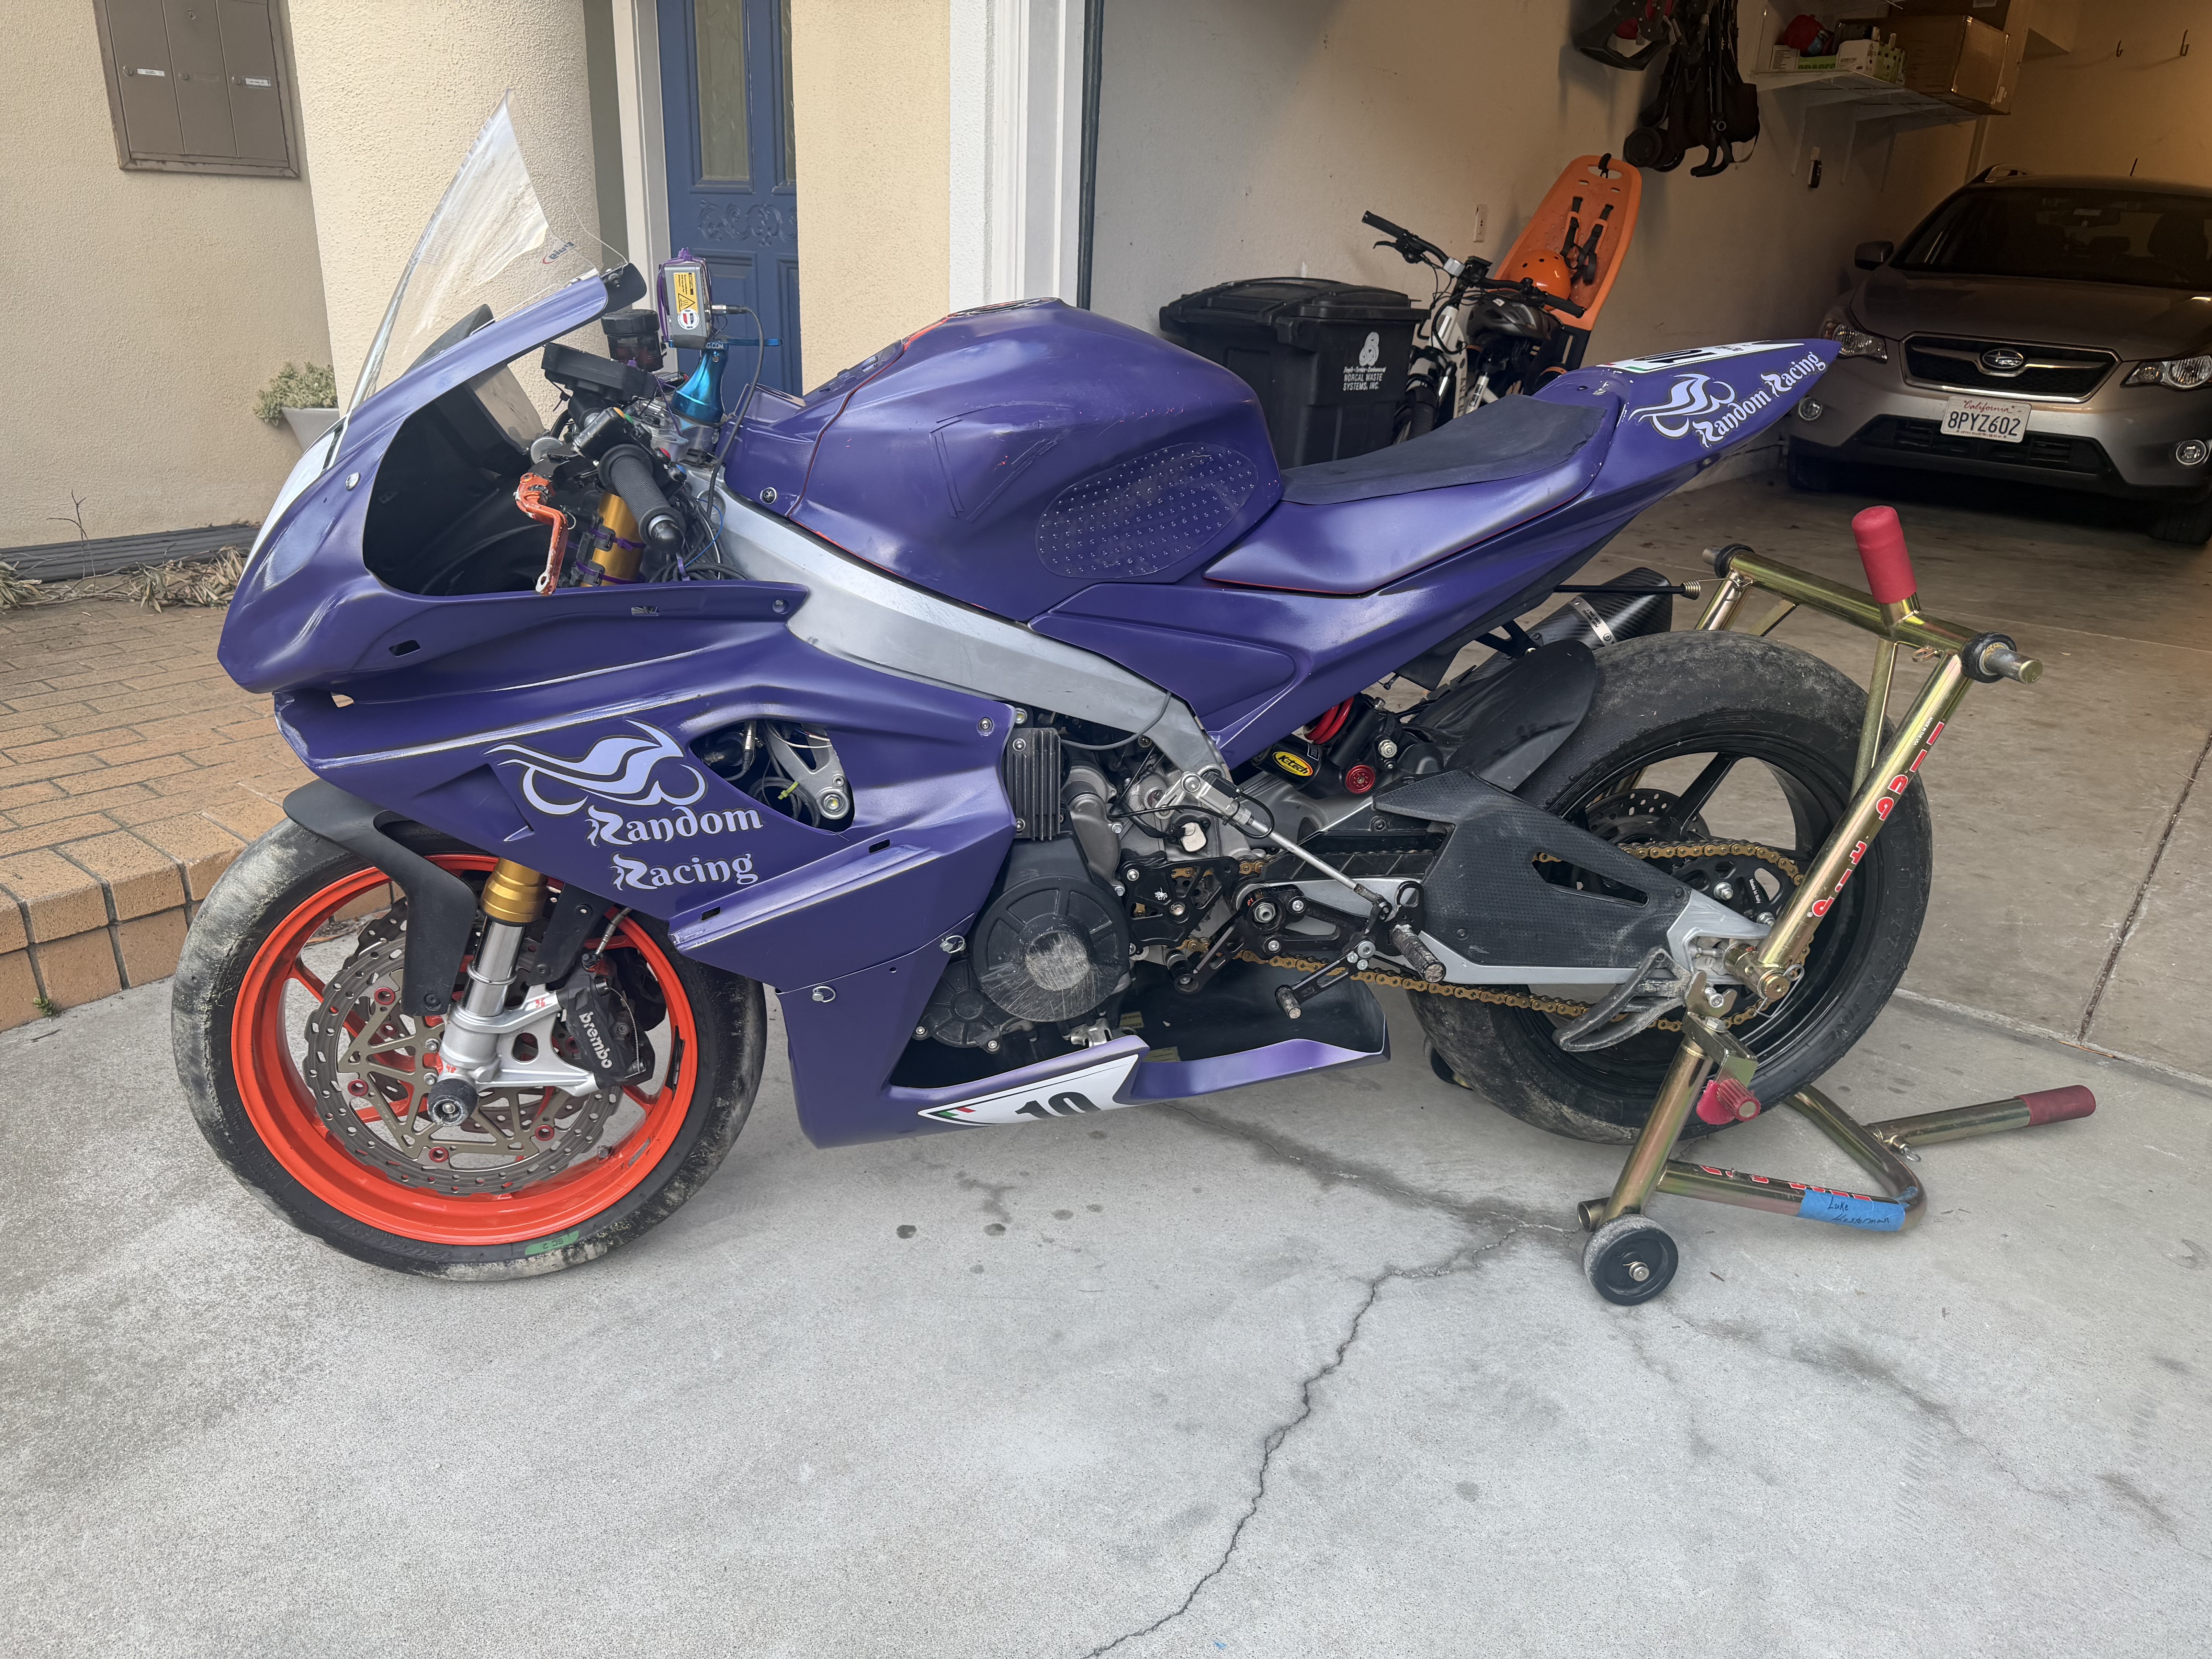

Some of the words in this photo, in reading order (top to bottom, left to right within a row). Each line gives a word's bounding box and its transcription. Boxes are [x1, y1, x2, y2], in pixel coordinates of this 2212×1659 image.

[1344, 373, 1364, 382] NORCAL
[1365, 373, 1382, 381] WASTE
[1369, 381, 1379, 390] INC.
[1693, 389, 1771, 448] Random
[1761, 351, 1826, 397] Racing
[1964, 400, 2013, 414] California
[1948, 411, 2020, 436] 8PYZ602
[1924, 717, 1933, 728] MADE
[585, 805, 763, 846] Random
[610, 853, 758, 890] Racing
[579, 1012, 612, 1068] brembo
[1015, 1092, 1101, 1120] 10
[551, 1238, 563, 1246] SC
